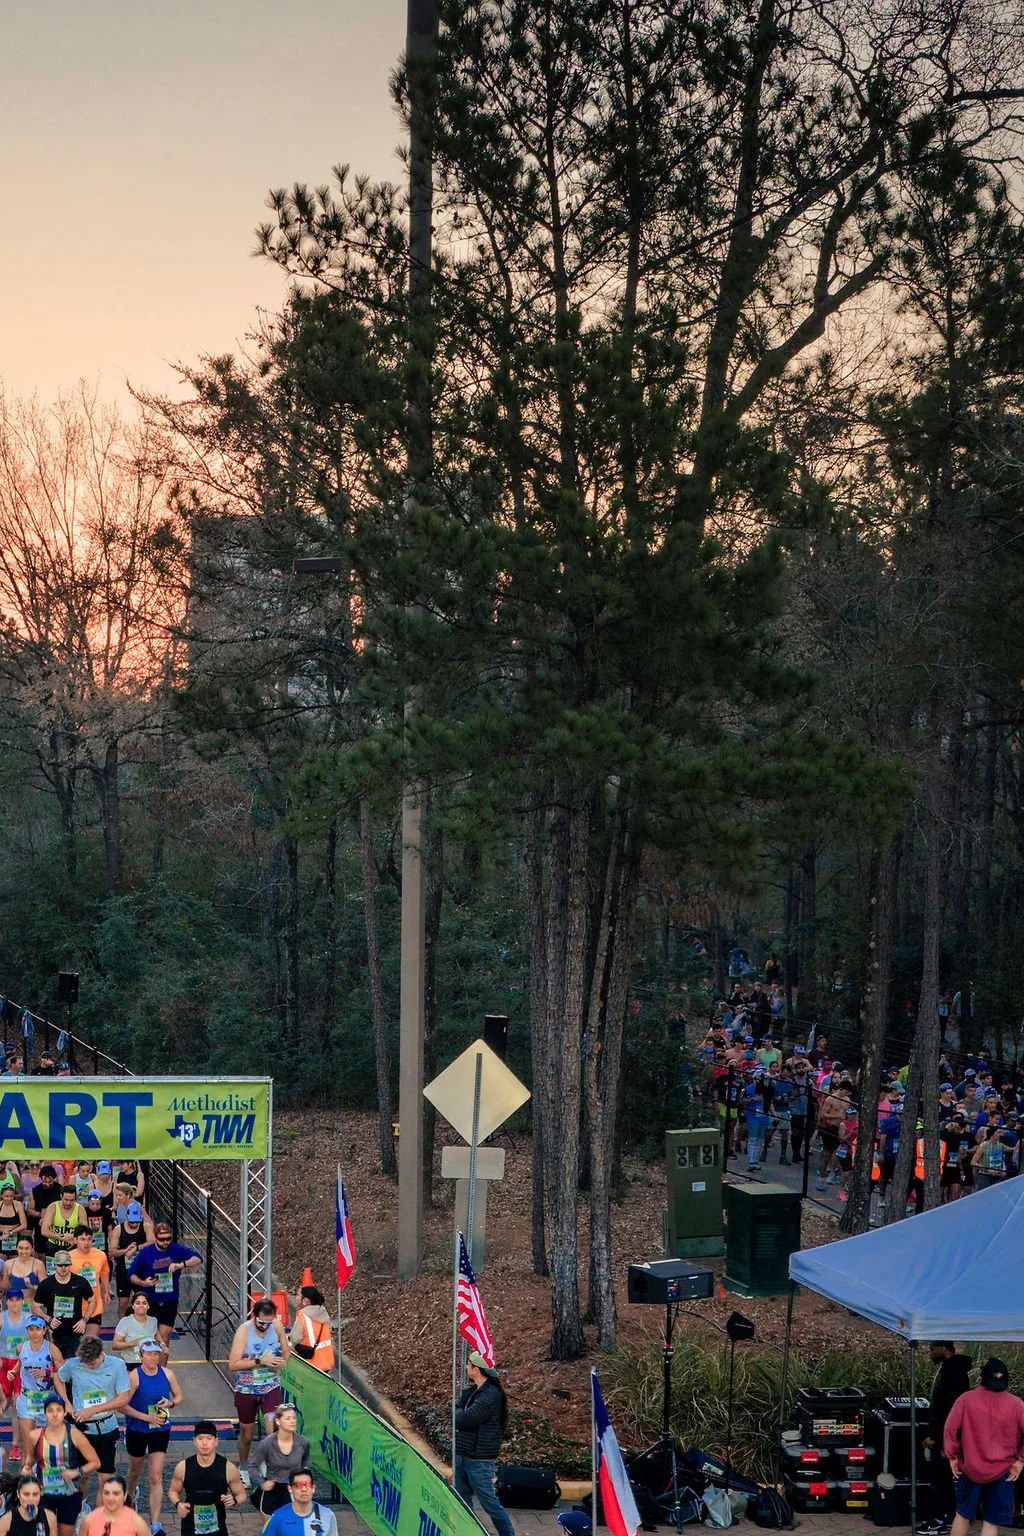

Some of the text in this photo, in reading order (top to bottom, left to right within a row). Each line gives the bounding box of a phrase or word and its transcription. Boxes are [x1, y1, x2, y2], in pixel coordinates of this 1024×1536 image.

[167, 1093, 257, 1111] Methodist
[202, 1114, 256, 1144] TWM
[328, 1393, 349, 1433] KAG
[332, 1433, 355, 1485] TWM
[370, 1444, 403, 1488] Methodist
[381, 1475, 402, 1533] TWM
